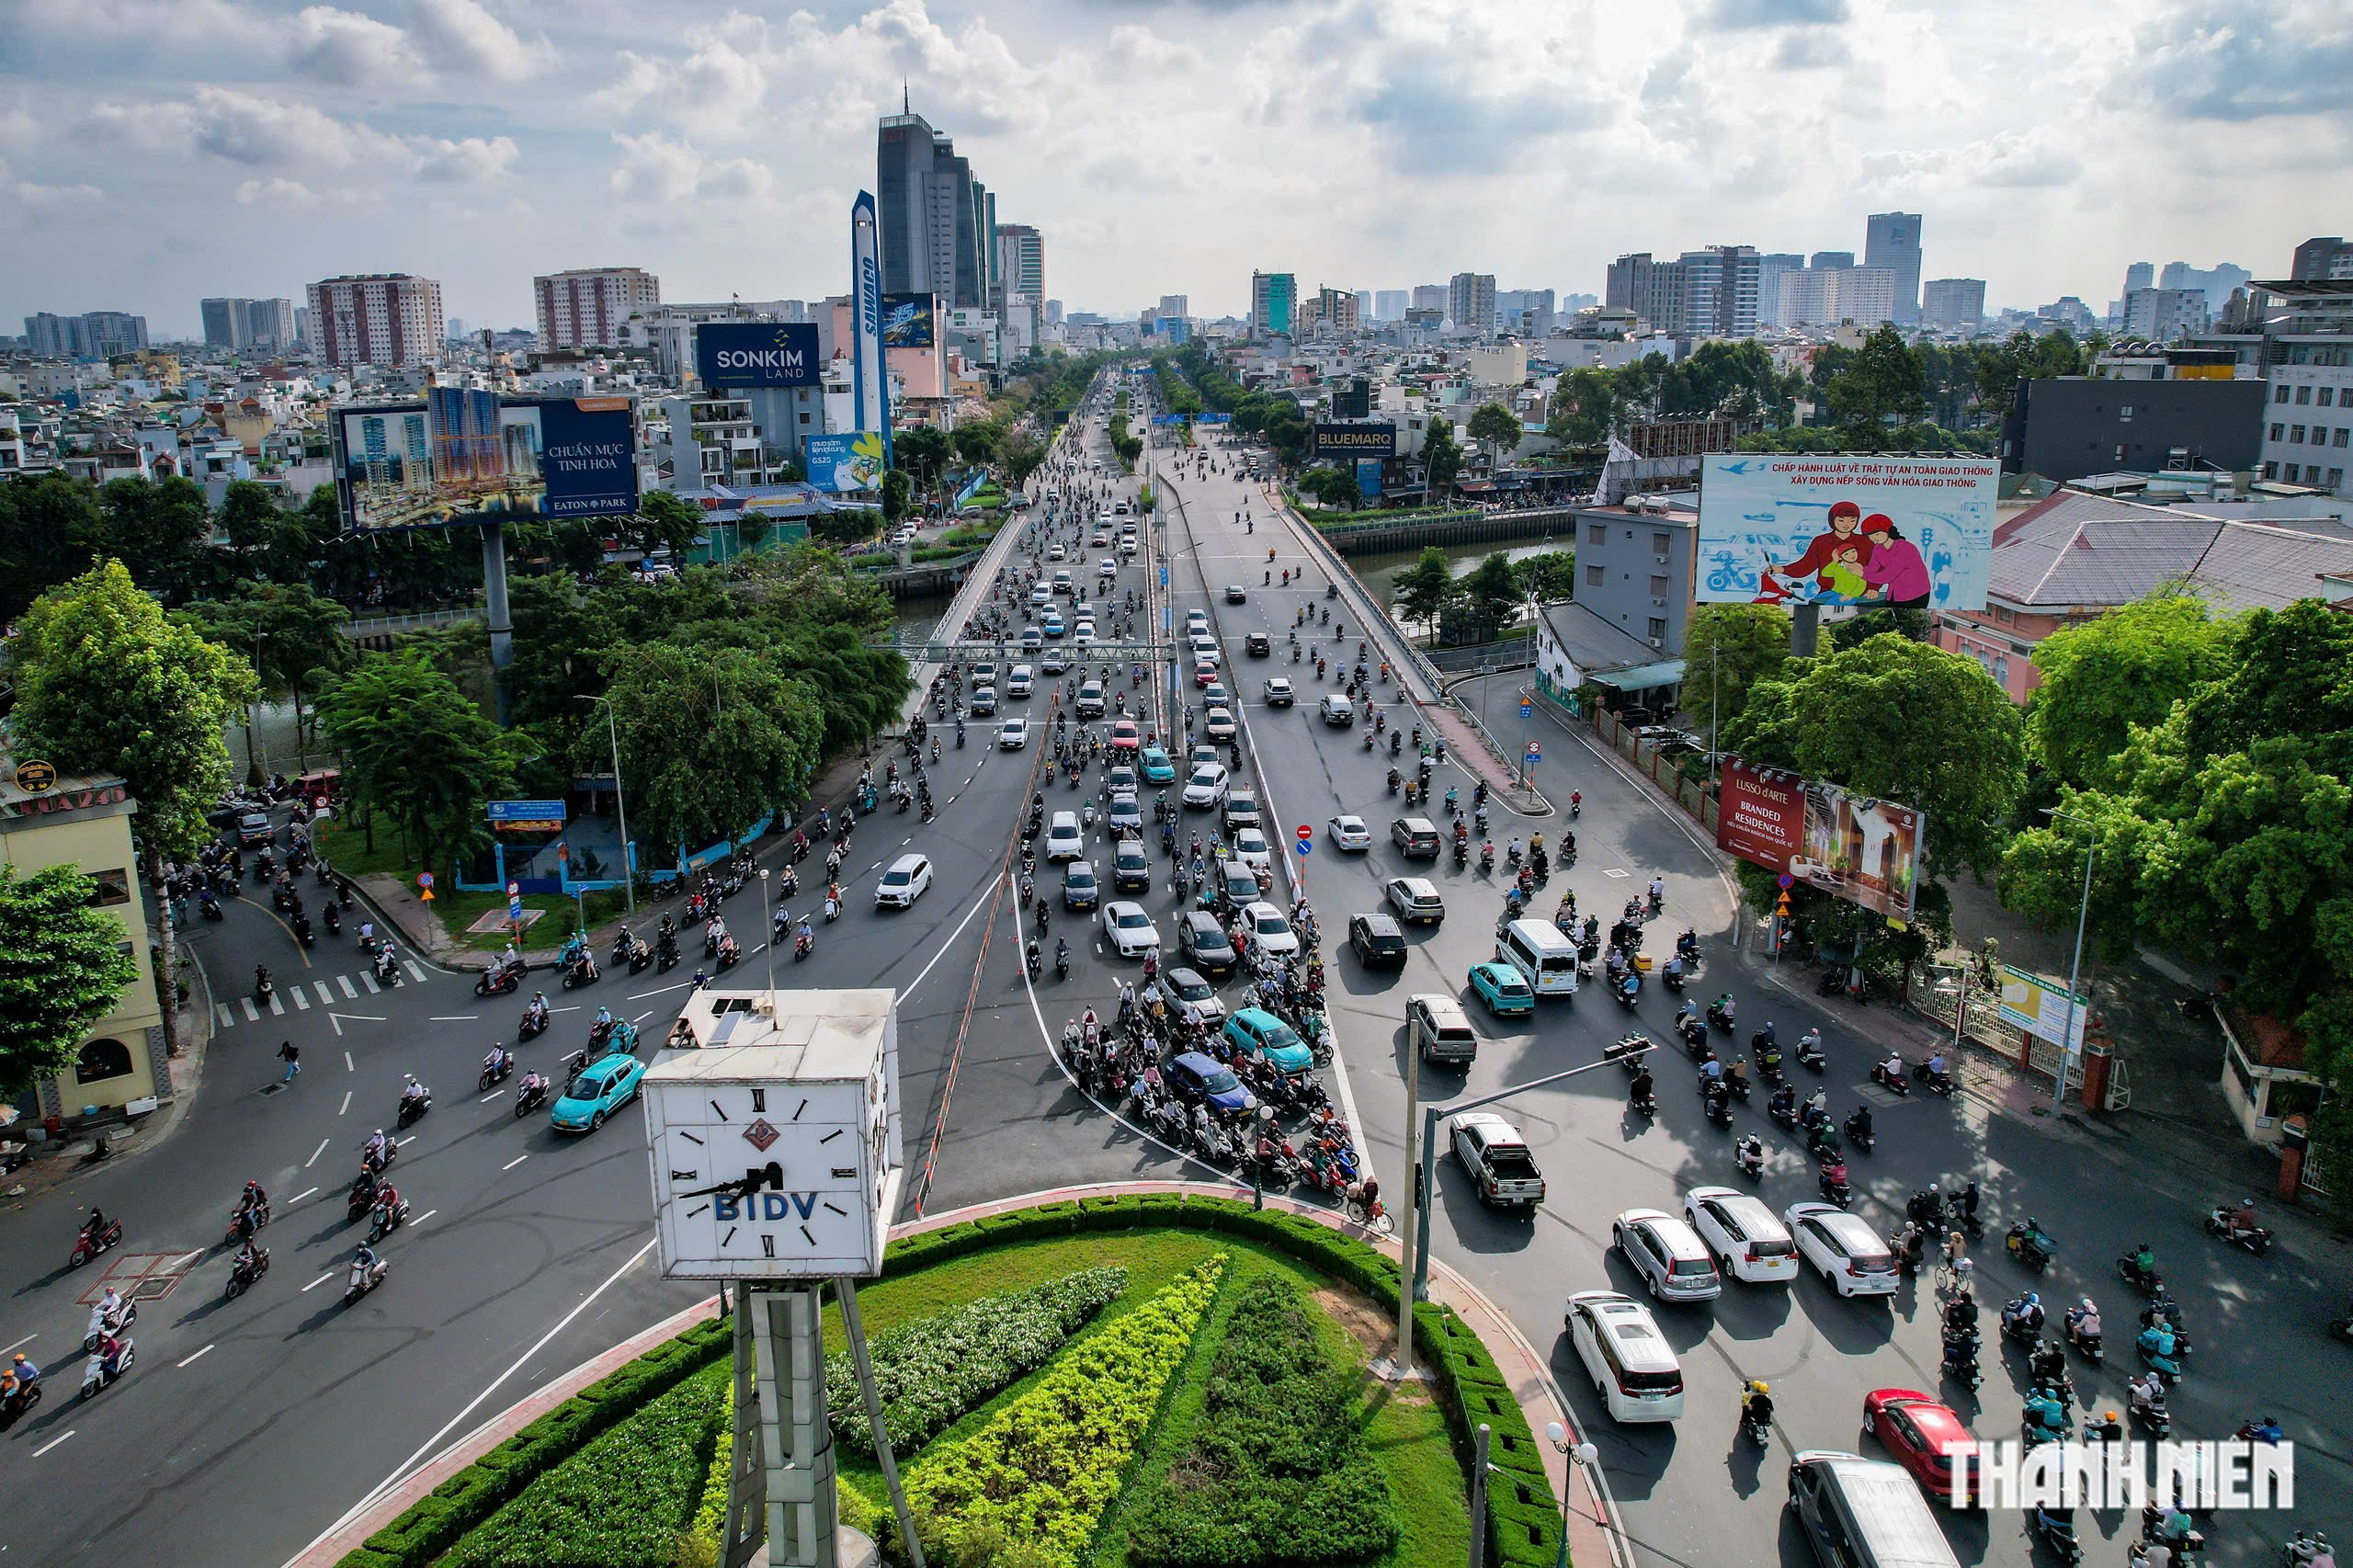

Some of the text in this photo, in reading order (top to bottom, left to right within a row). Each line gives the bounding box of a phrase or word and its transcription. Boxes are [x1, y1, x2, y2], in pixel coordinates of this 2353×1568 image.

[863, 256, 877, 337] SAWACO
[717, 349, 803, 368] SONKIM
[766, 368, 804, 379] LAND
[1318, 433, 1392, 445] BLUEMARQ
[549, 442, 625, 458] CHUẨN MỰC
[557, 459, 617, 472] TINH HOA
[1772, 461, 1994, 476] CHẤP HÀNH LUẬT VỀ TRẬT TỰ AN TOÀN GIAO THÔNG
[1790, 474, 1976, 488] XÂY DỰNG NẾP SỐNG VĂN HÓA GIAO THÔNG
[554, 498, 627, 510] EATON PARK
[1736, 778, 1761, 795] LUSSO
[1741, 801, 1780, 822] BRANDED
[1735, 812, 1785, 837] RESIDENCES
[715, 1192, 817, 1221] BIDV
